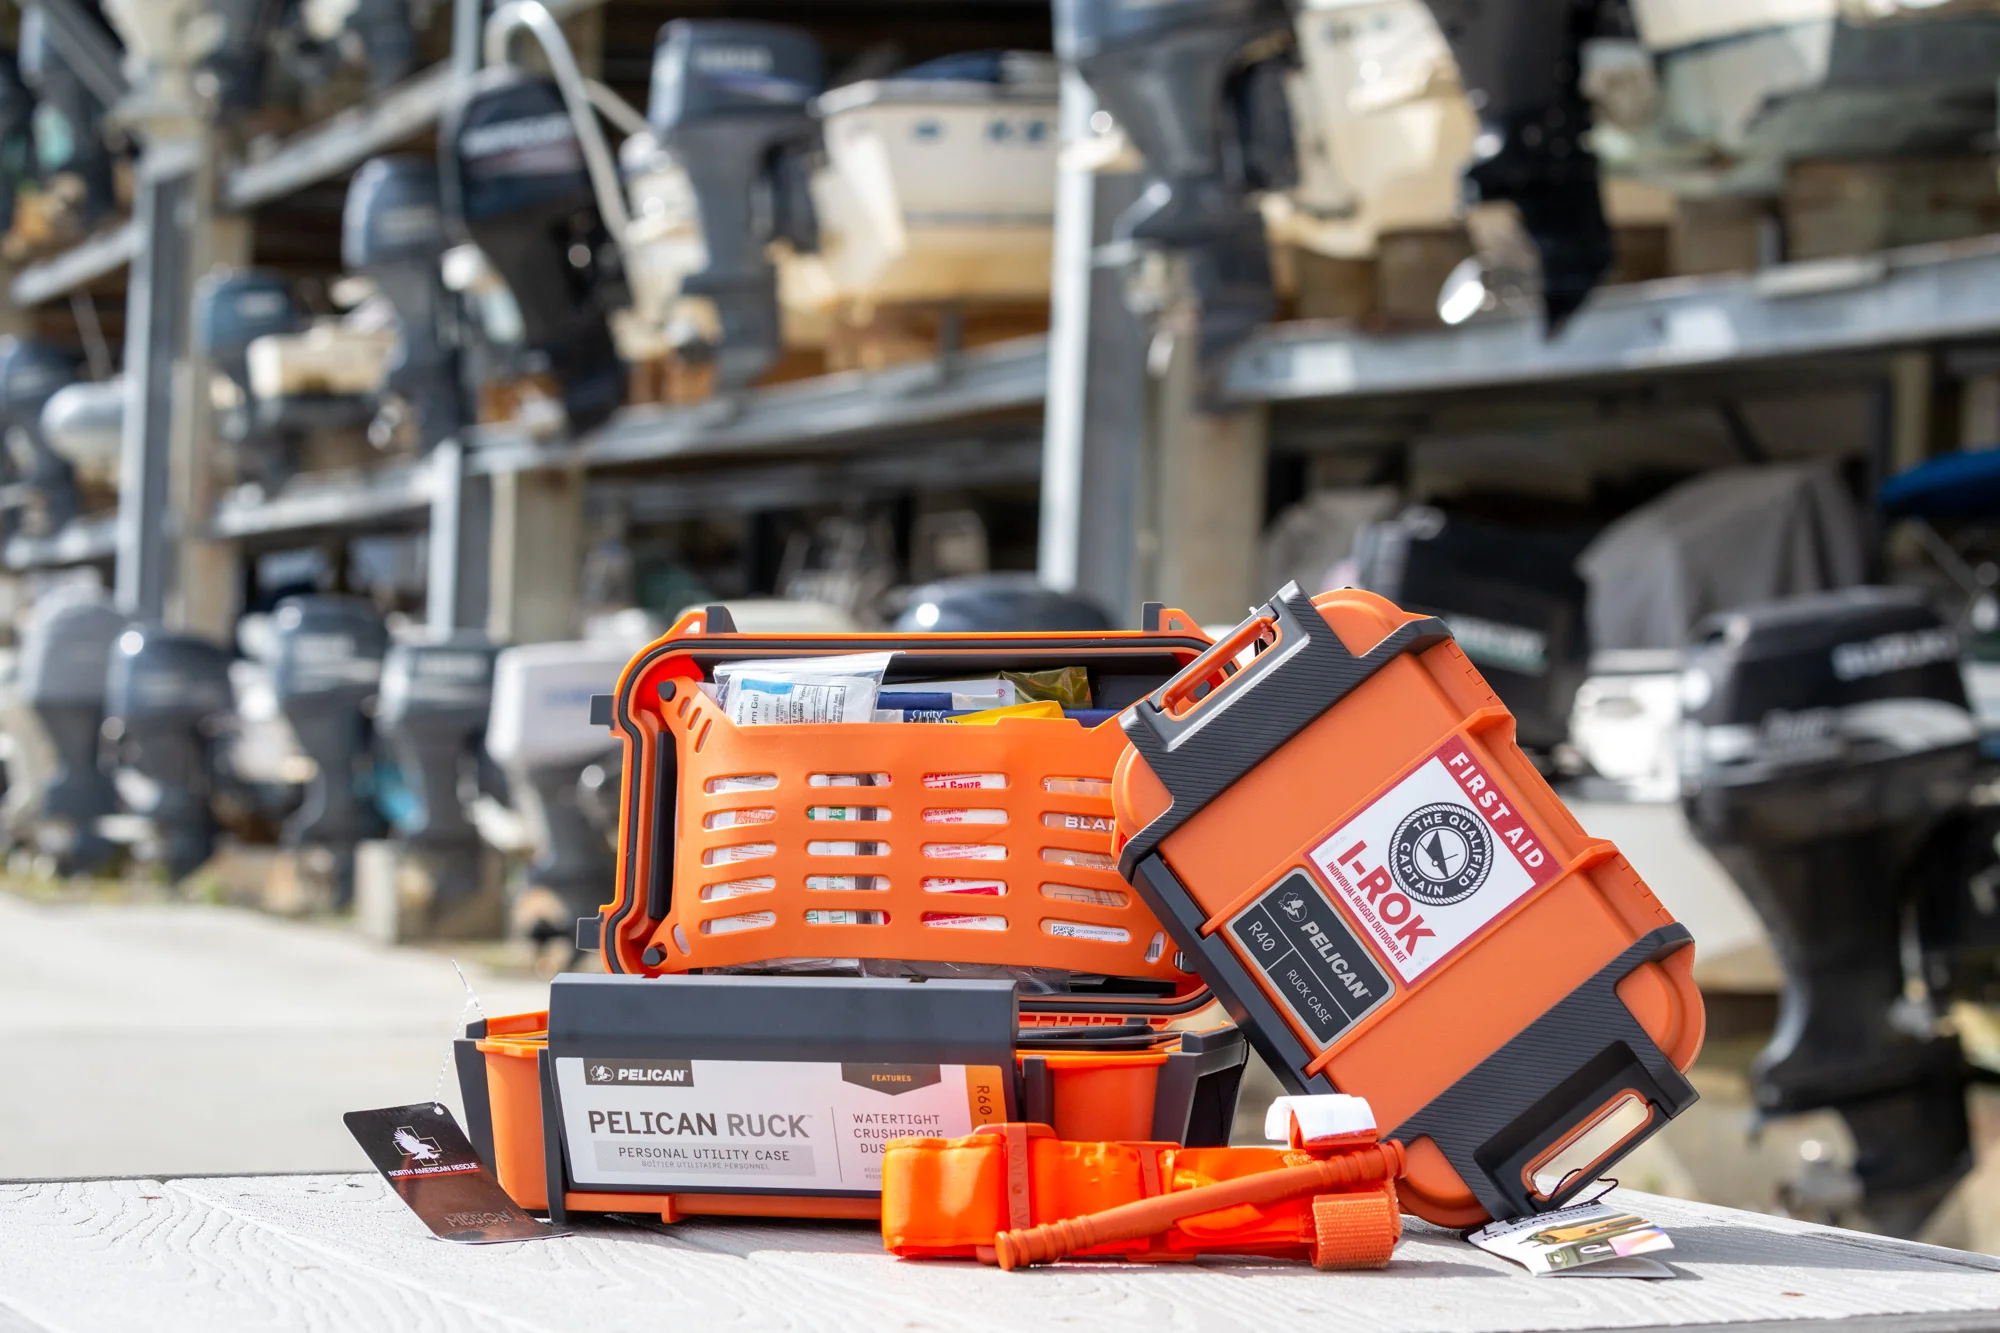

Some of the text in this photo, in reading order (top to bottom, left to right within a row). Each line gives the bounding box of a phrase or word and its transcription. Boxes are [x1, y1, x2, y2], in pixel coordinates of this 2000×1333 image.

[1449, 752, 1545, 868] FIRST AID
[1413, 813, 1483, 887] THE QUALIFIED
[1399, 842, 1444, 896] CAPTAIN
[1326, 861, 1356, 898] INDIVIDUAL
[1352, 894, 1376, 923] RUGGED
[1372, 920, 1398, 953] OUTDOOR
[1394, 949, 1408, 963] KIT
[1337, 840, 1437, 957] I-ROK
[1248, 920, 1275, 951] R40
[1286, 969, 1333, 1025] RUCK CASE
[872, 1074, 912, 1082] FEATURES
[588, 1110, 717, 1136] PELICAN
[853, 1113, 940, 1125] WATERTIGHT
[387, 1162, 478, 1177] NORTH AMERICAN RESCUE
[618, 1147, 790, 1161] PERSONAL UTILITY CASE
[676, 1160, 722, 1169] UTILITAIRE
[724, 1162, 769, 1170] PERSONNEL
